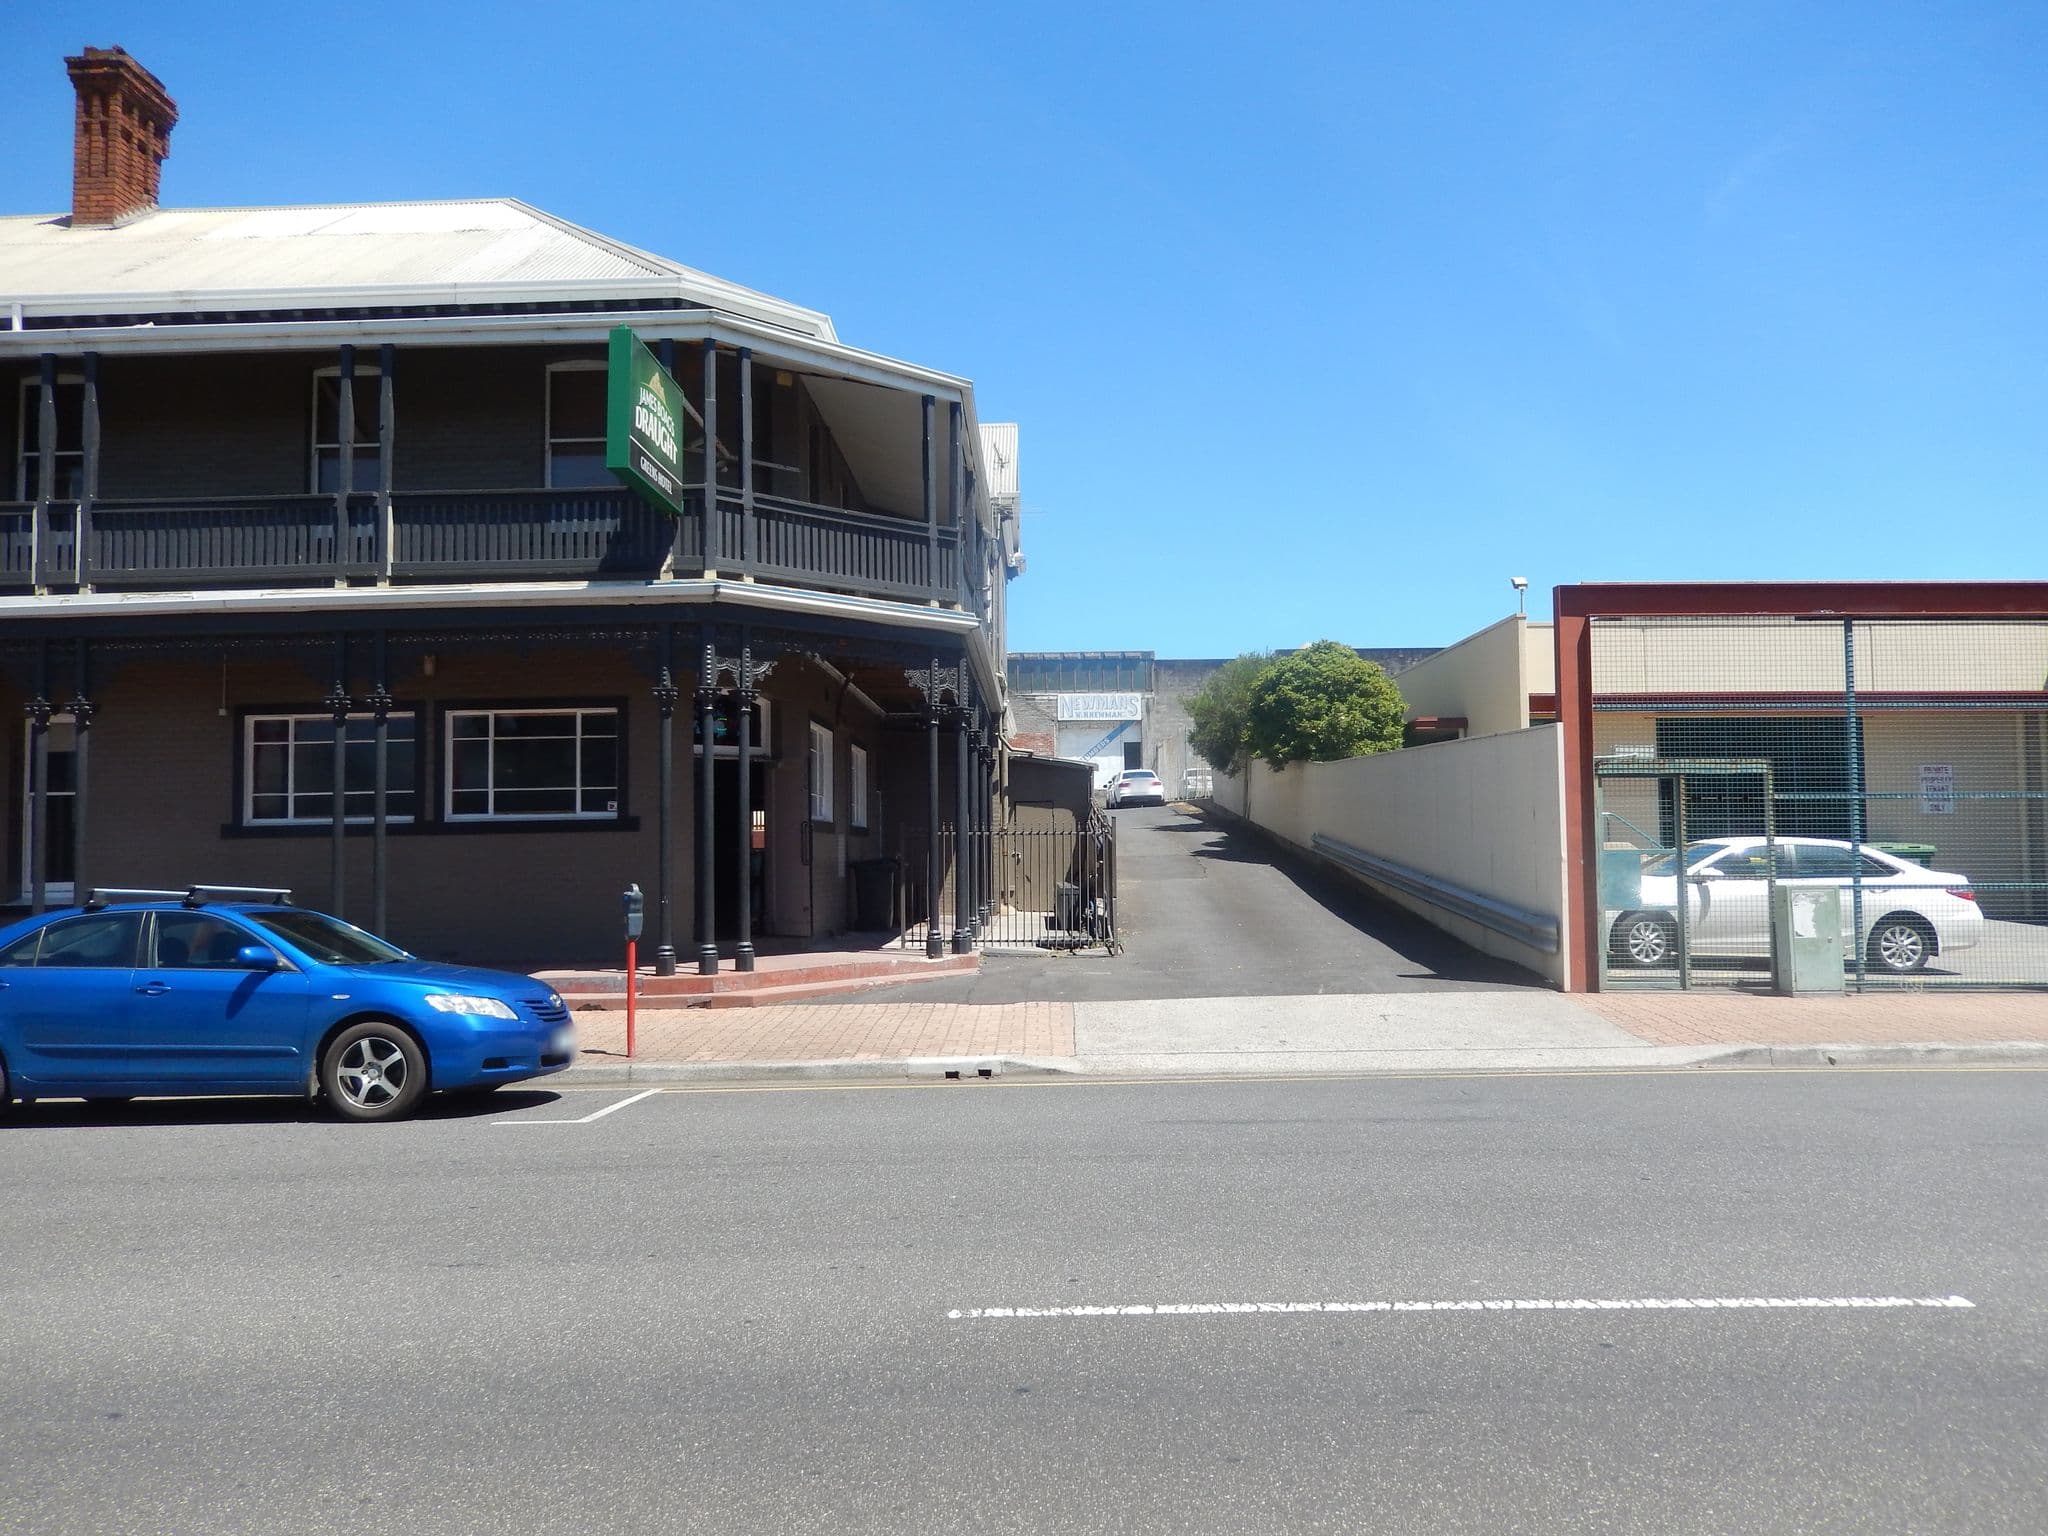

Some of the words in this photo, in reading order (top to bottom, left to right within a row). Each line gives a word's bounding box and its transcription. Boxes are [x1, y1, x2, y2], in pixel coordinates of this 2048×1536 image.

[639, 387, 657, 412] JAMES
[635, 405, 678, 464] DRAUGHT
[1059, 695, 1139, 718] NEWMANS
[1923, 766, 1949, 774] PRIVATE
